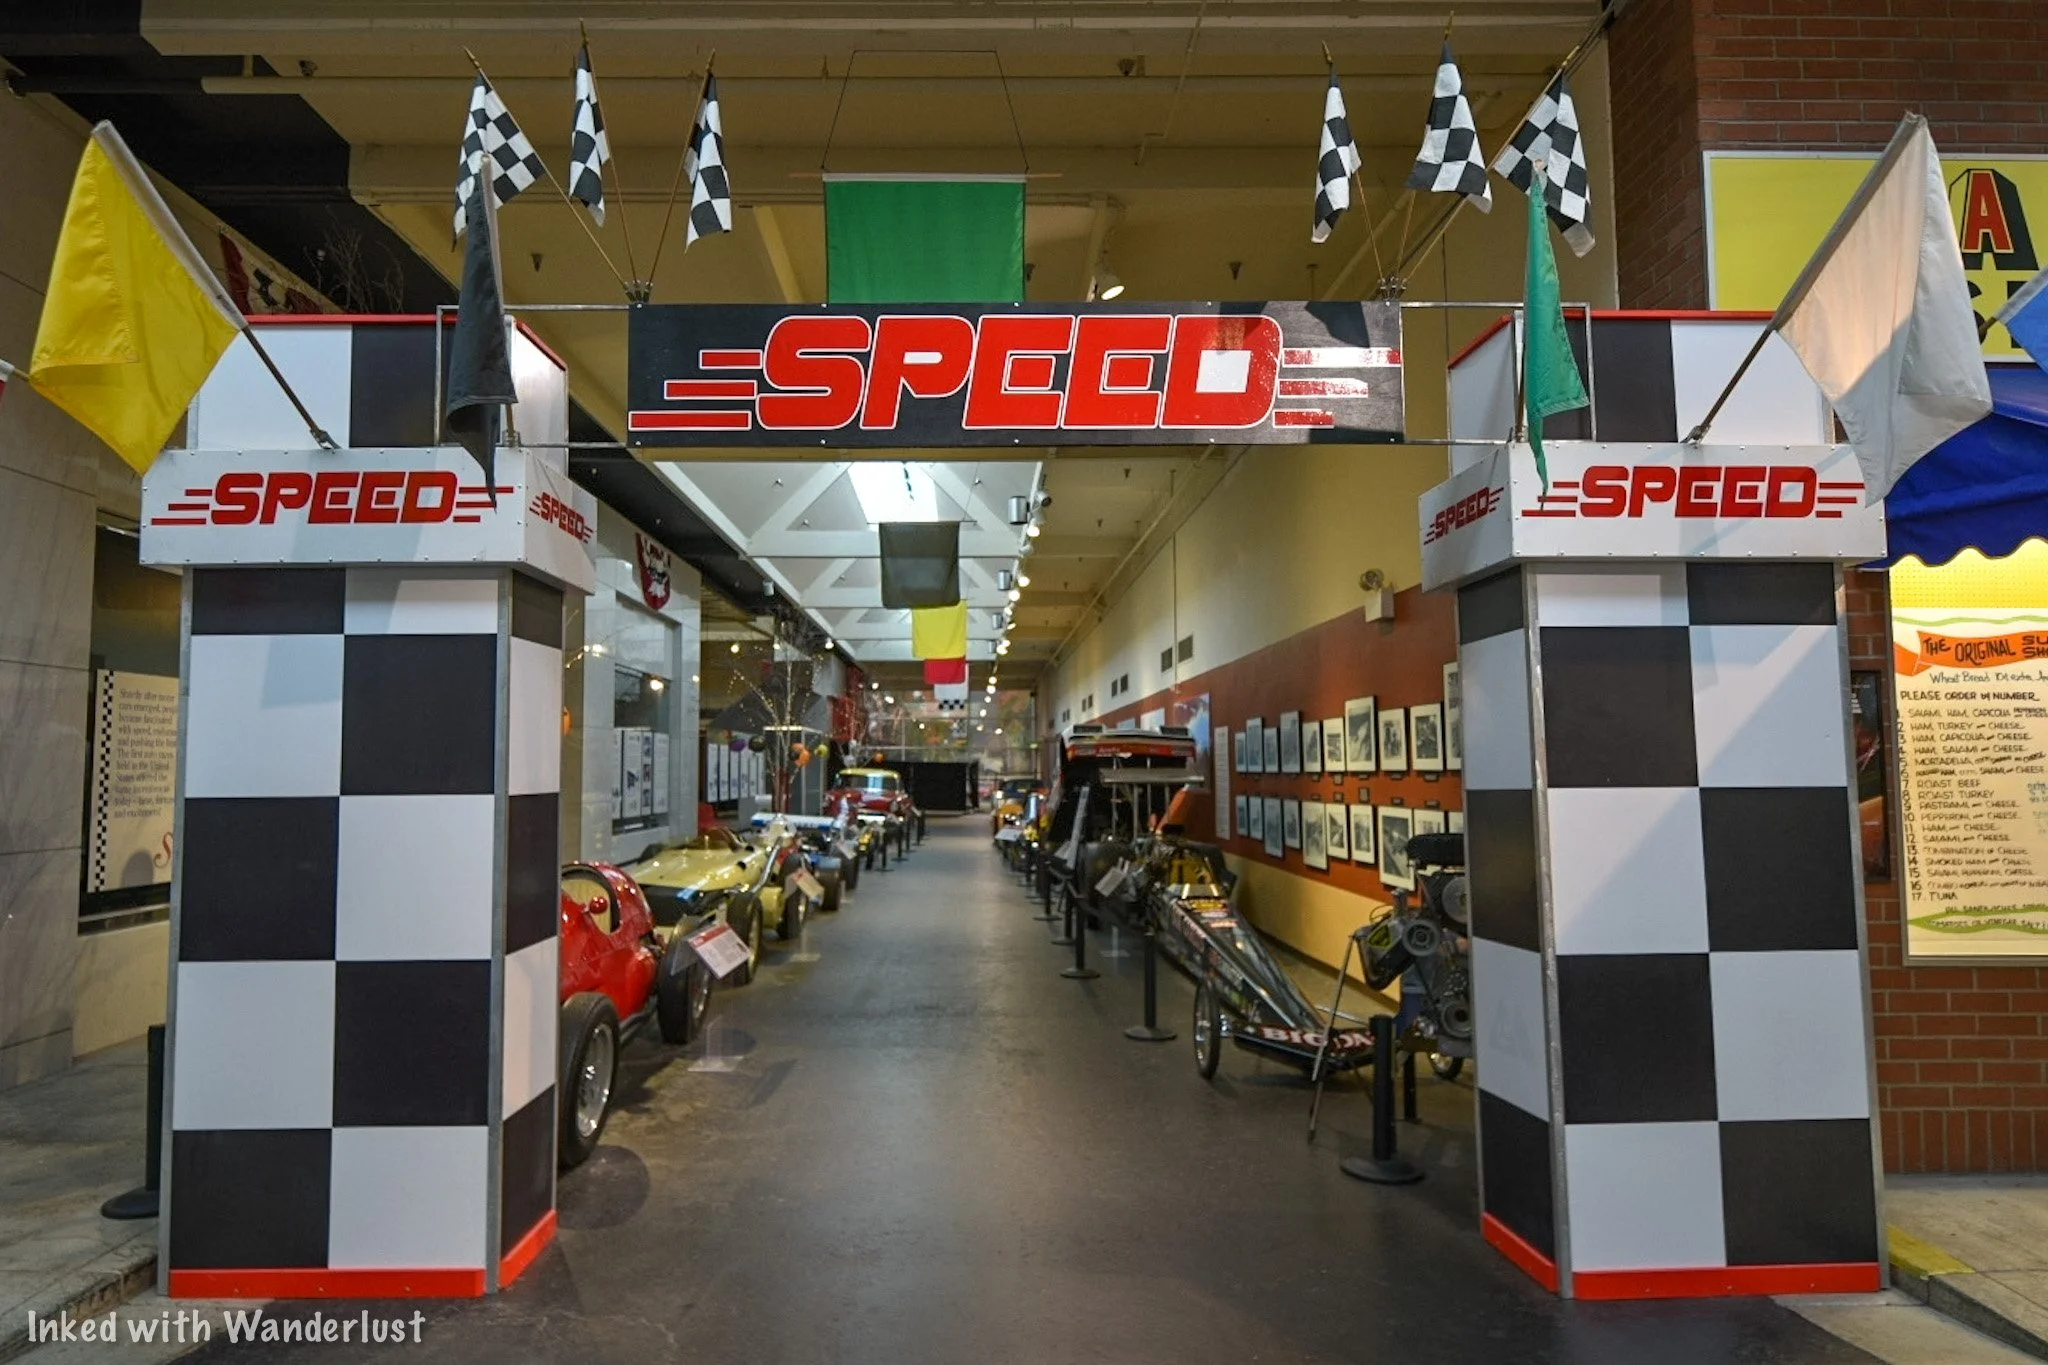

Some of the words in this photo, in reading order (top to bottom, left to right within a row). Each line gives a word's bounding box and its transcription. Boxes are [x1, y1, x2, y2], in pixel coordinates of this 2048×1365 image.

[755, 315, 1283, 430] SPEED
[1580, 466, 1818, 517] SPEED
[211, 471, 457, 525] SPEED
[541, 492, 584, 541] SPEED
[1435, 487, 1489, 539] SPEED
[1923, 637, 1951, 656] THE
[1954, 639, 2017, 666] ORIGINAL
[1900, 691, 1941, 700] PLEASE
[1944, 691, 1976, 700] ORDER
[1992, 690, 2040, 701] NUMBER
[1937, 722, 1973, 730] TURKEY
[1988, 722, 2025, 730] CHEESE
[1899, 734, 1906, 744] 3
[1903, 780, 1909, 788] 7
[1917, 780, 1952, 788] ROAST
[1958, 779, 1981, 788] BEEF
[1903, 790, 1910, 801] 8
[1918, 791, 1954, 800] ROAST
[1959, 790, 1995, 799] TURKEY
[1904, 800, 1911, 811] 9
[1904, 813, 1915, 821] 10
[1904, 822, 1914, 832] 11
[1963, 822, 2000, 830] CHEESE
[1906, 834, 1916, 844] 12
[1908, 845, 1917, 855] 13
[1908, 855, 1918, 865] 14
[1909, 868, 1920, 878] 15
[1910, 880, 1922, 891] 16
[1912, 892, 1921, 901] 17
[1929, 891, 1958, 901] TUNA
